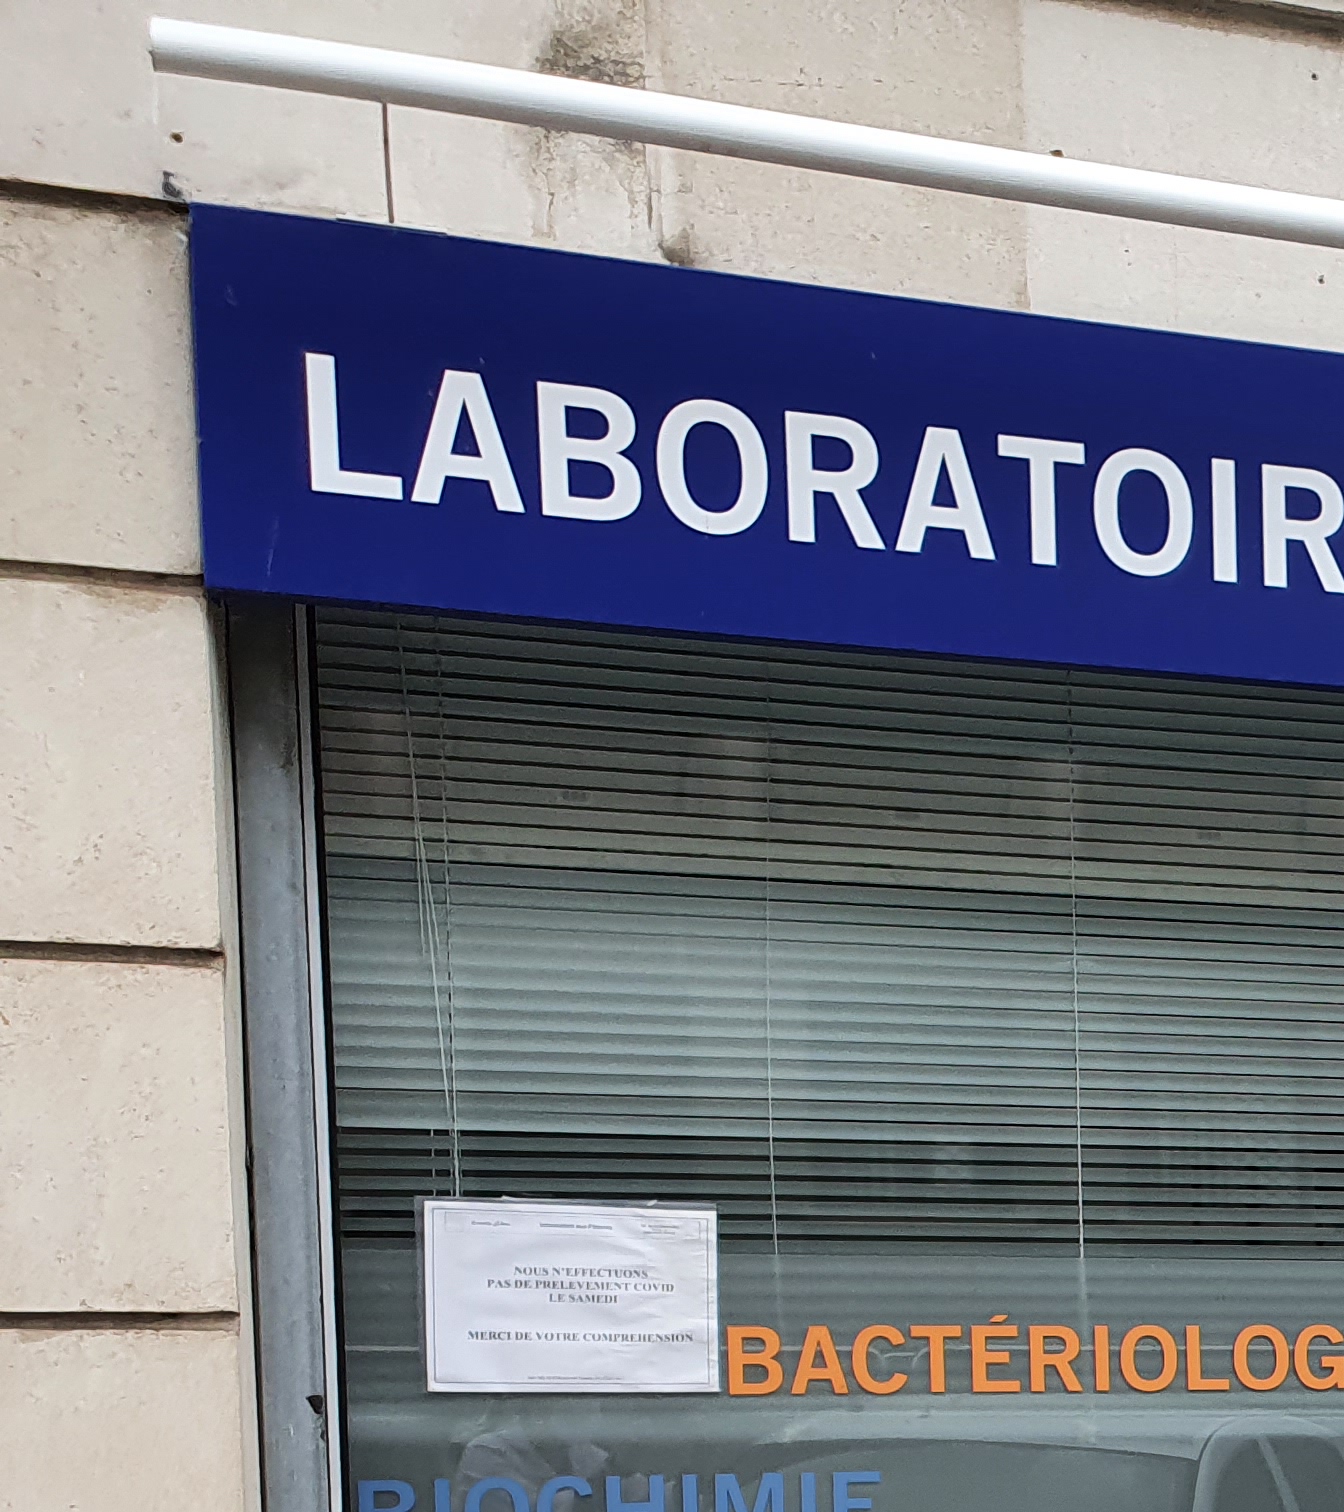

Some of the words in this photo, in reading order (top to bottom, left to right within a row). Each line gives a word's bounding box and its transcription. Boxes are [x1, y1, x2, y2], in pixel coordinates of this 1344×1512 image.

[513, 1266, 549, 1278] NOUS
[552, 1267, 648, 1279] N'EFFECTUONS
[487, 1279, 513, 1289] PAS
[515, 1279, 533, 1289] DE
[535, 1279, 631, 1291] PRELEVEMENT
[633, 1282, 674, 1292] COVID
[549, 1293, 565, 1303] LE
[568, 1293, 618, 1304] SAMEDI
[467, 1330, 512, 1341] MERCI
[515, 1331, 532, 1342] DE
[536, 1332, 580, 1342] VOTRE
[582, 1332, 693, 1343] COMPREHENSION
